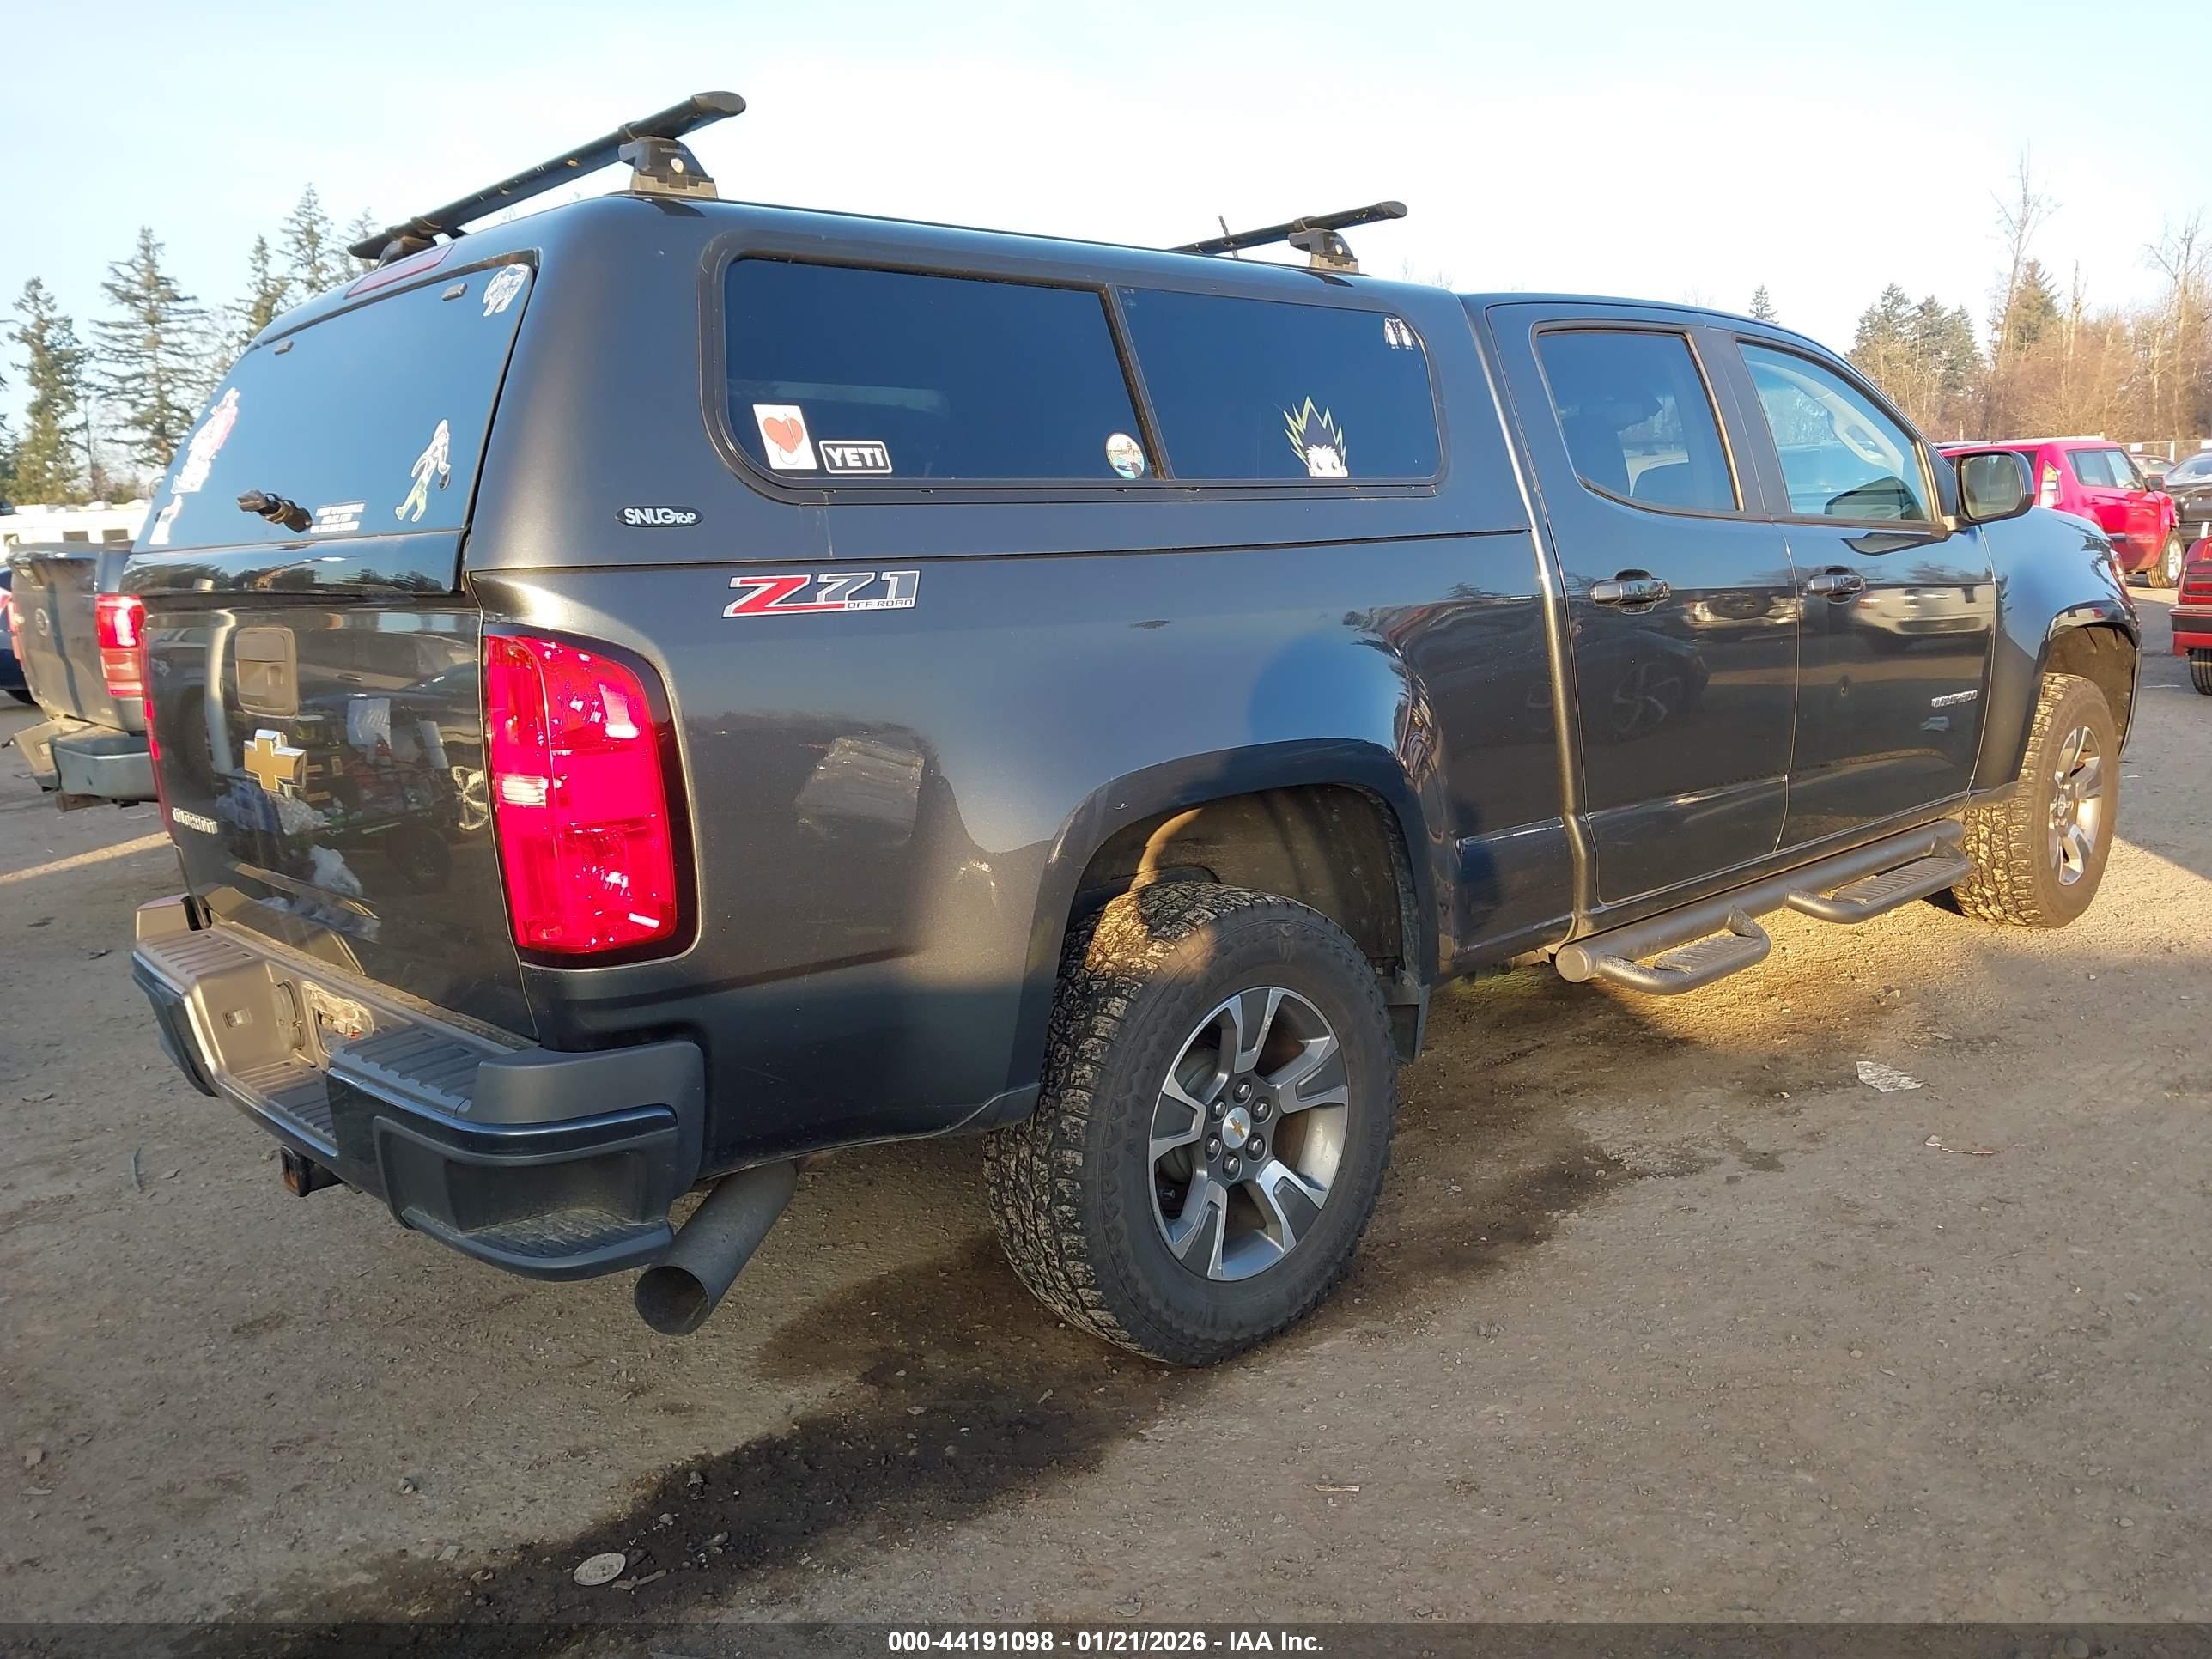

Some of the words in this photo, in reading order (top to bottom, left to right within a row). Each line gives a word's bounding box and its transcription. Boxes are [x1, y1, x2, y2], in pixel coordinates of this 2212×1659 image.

[824, 447, 885, 467] YETI
[722, 570, 921, 618] Z71
[878, 599, 912, 607] ROAD
